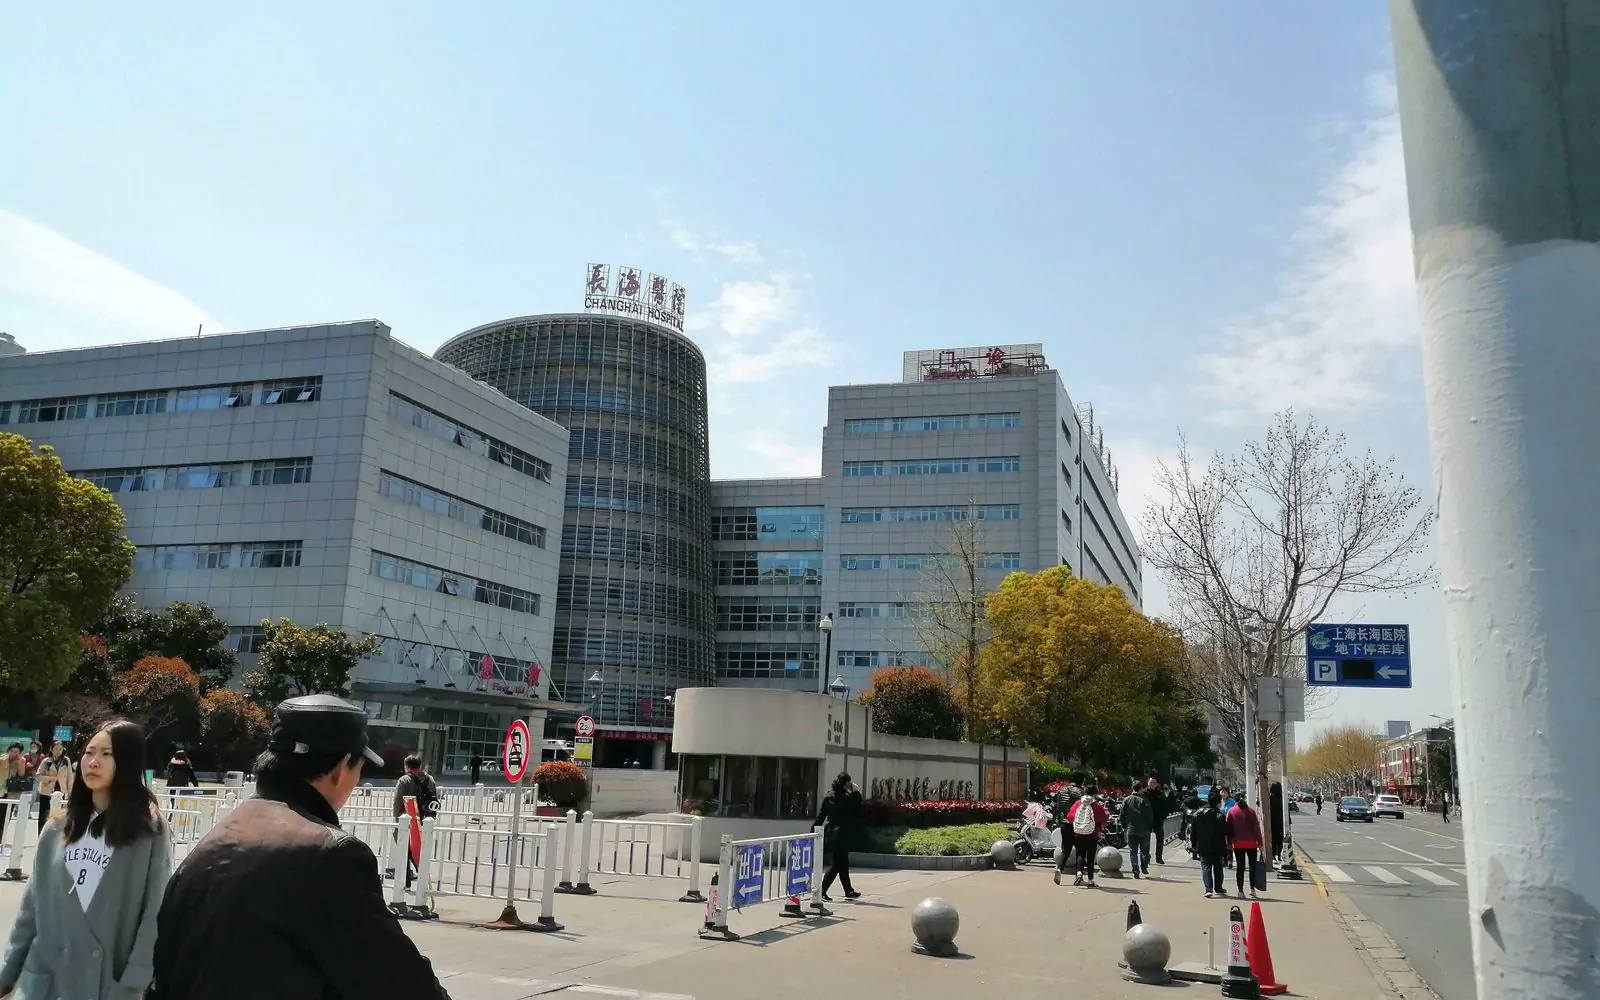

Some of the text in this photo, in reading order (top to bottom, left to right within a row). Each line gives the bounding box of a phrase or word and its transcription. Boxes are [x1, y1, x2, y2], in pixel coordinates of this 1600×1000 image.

[584, 297, 685, 332] CHANGHAI HOSPITAL
[1332, 628, 1406, 641] 上海长海医院
[1335, 643, 1406, 656] 地下停车库
[1319, 664, 1332, 678] P
[740, 848, 764, 879] 出口
[791, 845, 812, 870] 进口
[77, 868, 87, 885] 8
